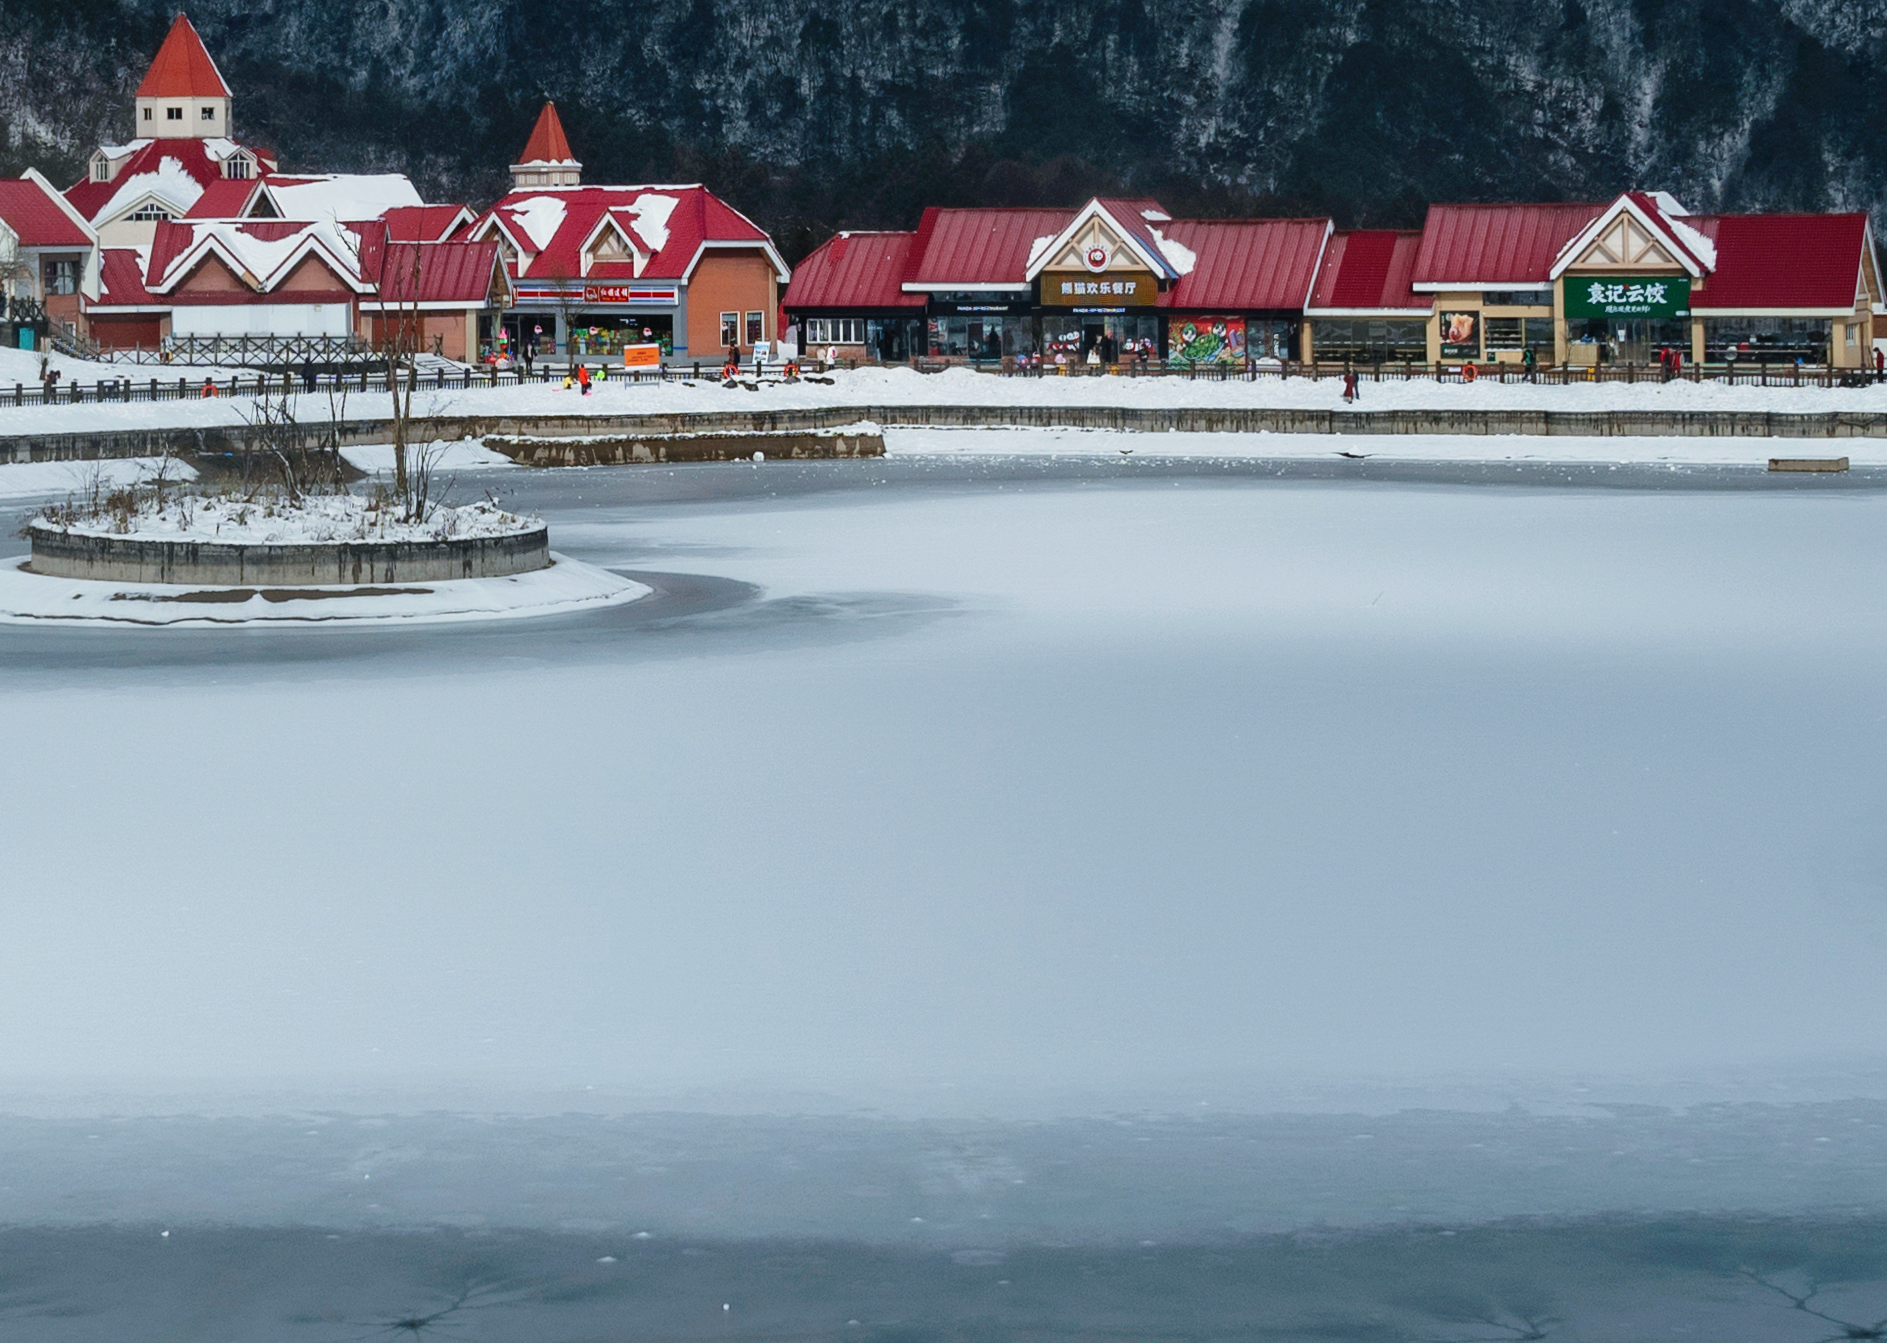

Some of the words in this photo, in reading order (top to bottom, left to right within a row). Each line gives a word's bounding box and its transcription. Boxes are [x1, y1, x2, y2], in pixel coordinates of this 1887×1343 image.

[1061, 282, 1137, 295] 熊猫欢乐餐厅
[1586, 282, 1668, 304] 袁记云饺
